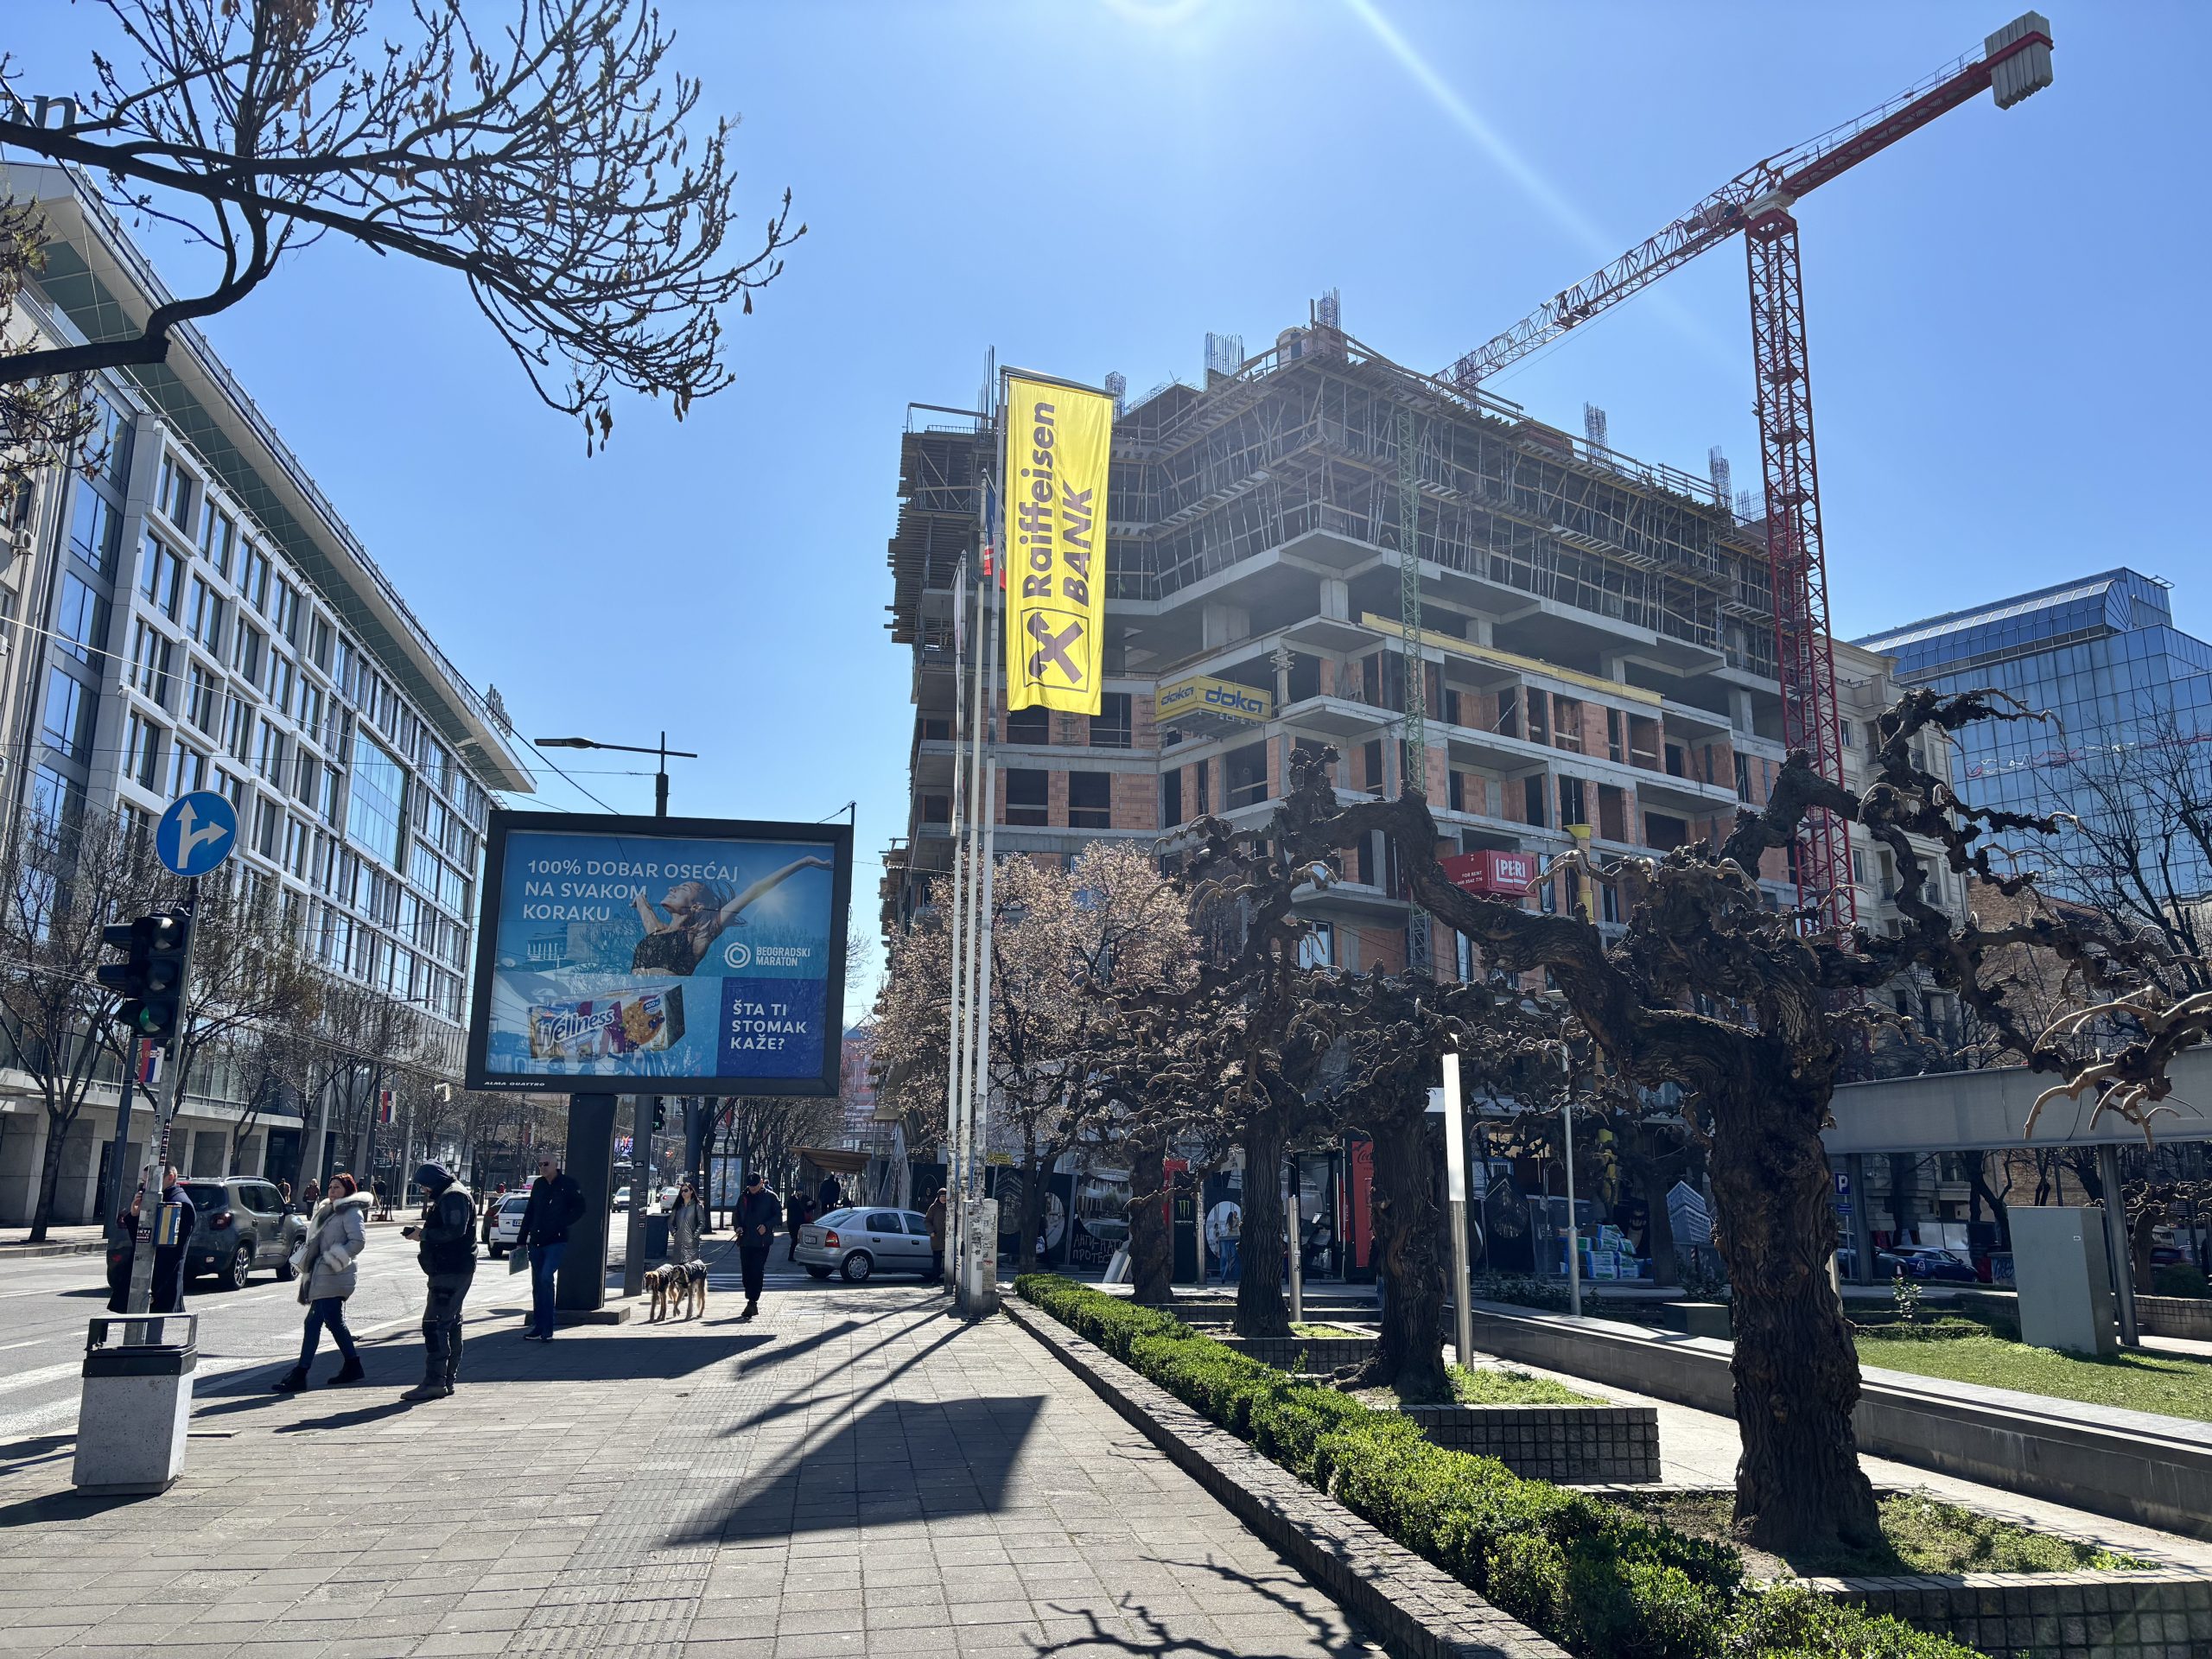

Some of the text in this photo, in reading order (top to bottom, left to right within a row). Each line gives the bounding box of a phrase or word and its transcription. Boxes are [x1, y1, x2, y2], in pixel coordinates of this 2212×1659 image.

[1018, 401, 1055, 599] Raiffeisen
[1062, 480, 1093, 607] BANK
[1160, 686, 1194, 706] doka
[1205, 685, 1263, 714] doka
[528, 858, 739, 882] 100% DOBAR OSEĆAJ
[1500, 859, 1526, 878] PERI
[524, 881, 646, 899] NA SVAKOM
[522, 904, 610, 922] KORAKU
[756, 946, 810, 957] BEOGRADSKI
[755, 957, 798, 967] MARATON
[733, 999, 787, 1016] ŠTA TI
[537, 1008, 615, 1053] Wellness
[732, 1020, 807, 1033] STOMAK
[730, 1033, 785, 1051] KAŽE?
[1838, 1174, 1848, 1193] P
